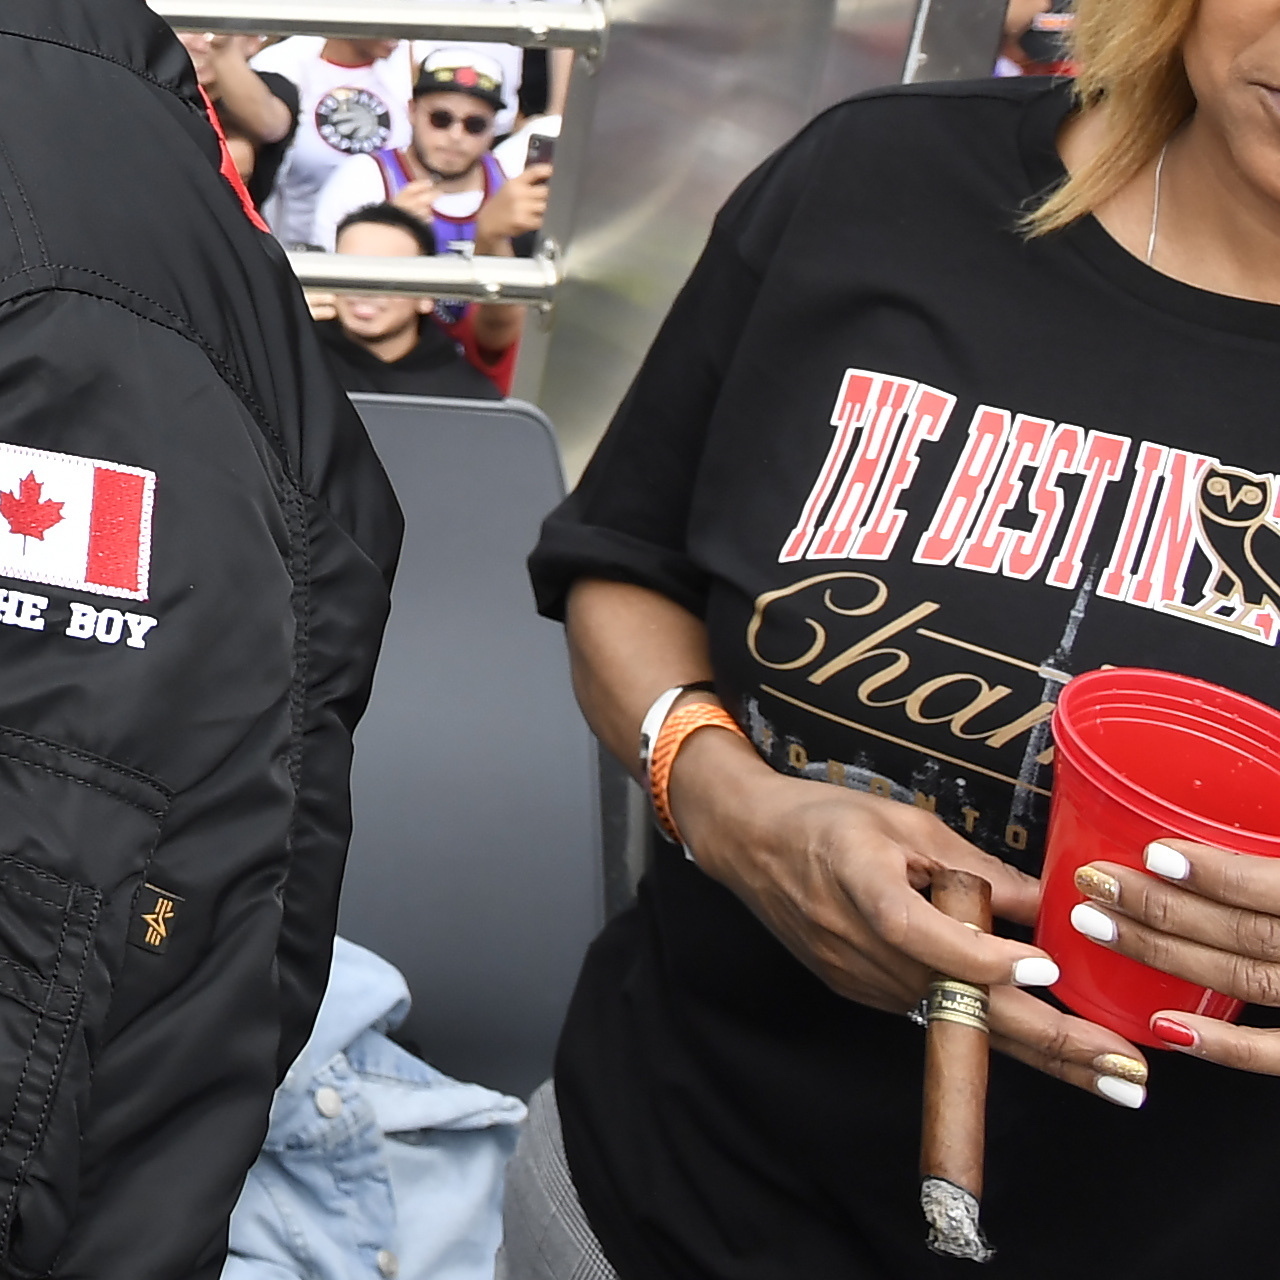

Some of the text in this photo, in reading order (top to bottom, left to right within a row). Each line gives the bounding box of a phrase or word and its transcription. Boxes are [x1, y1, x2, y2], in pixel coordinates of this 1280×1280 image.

[778, 368, 1219, 611] THE BEST IN
[65, 602, 158, 649] BOY
[956, 994, 982, 1010] LIGA
